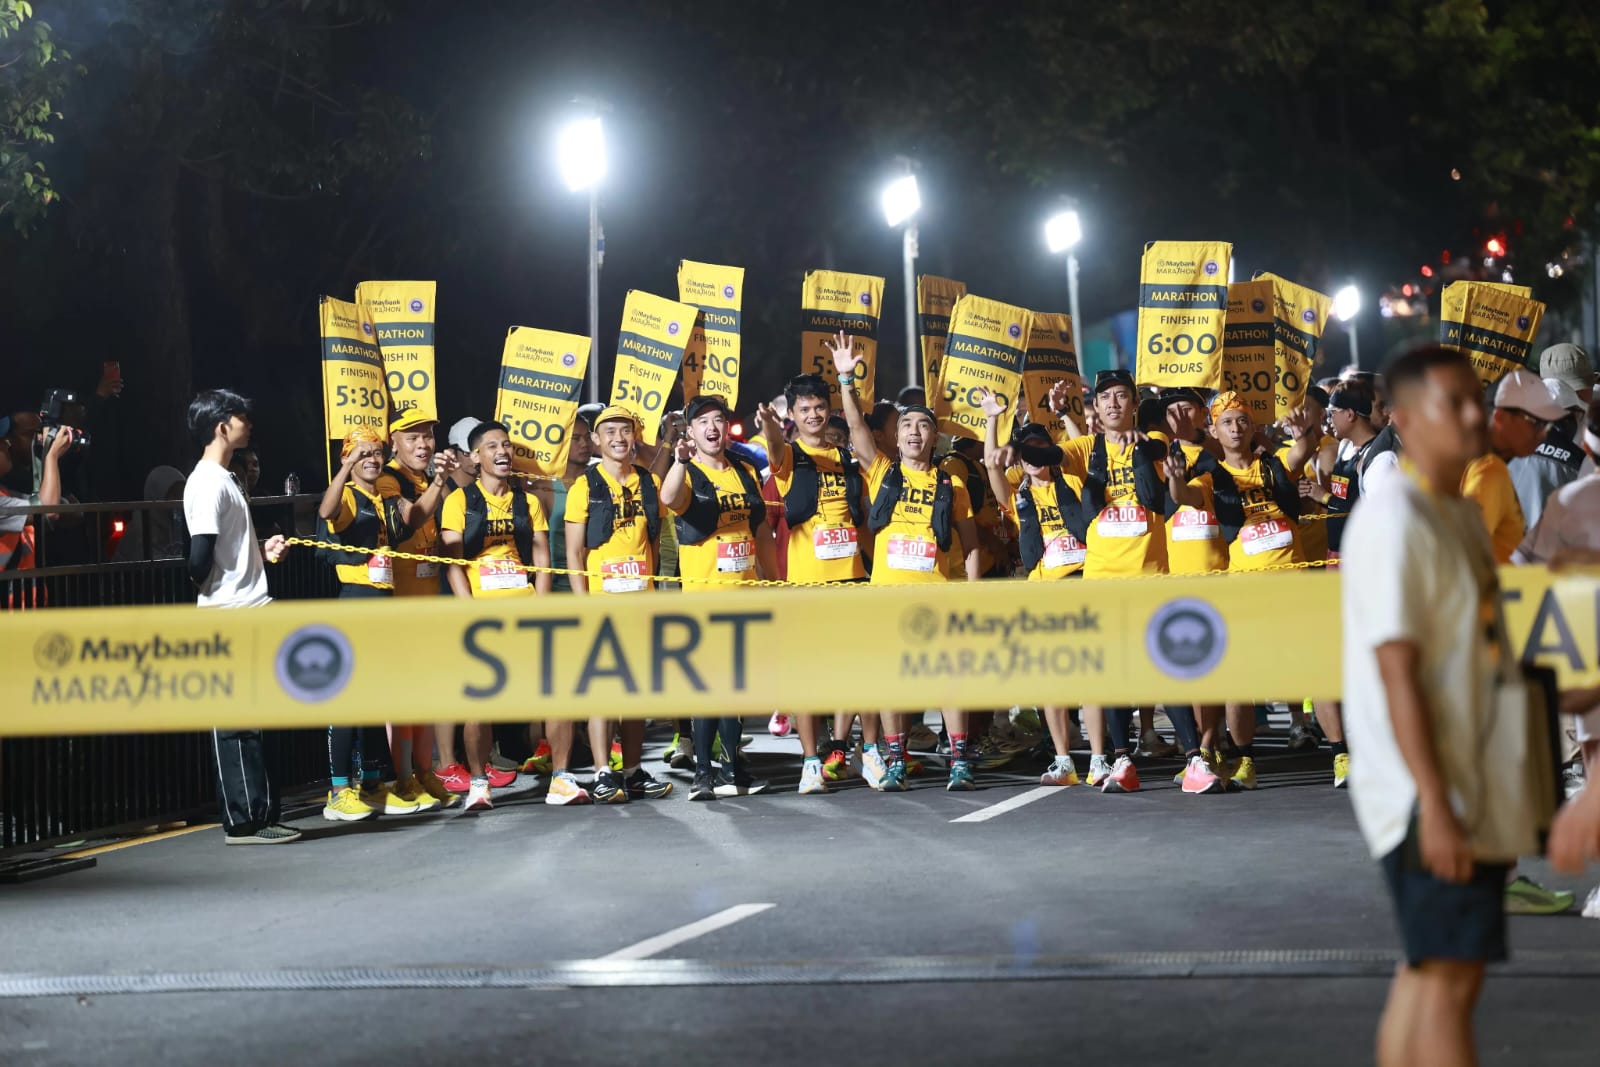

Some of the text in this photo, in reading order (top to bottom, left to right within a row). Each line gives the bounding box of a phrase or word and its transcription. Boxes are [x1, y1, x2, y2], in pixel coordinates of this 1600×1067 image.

[1156, 267, 1197, 275] MARATHON
[1166, 260, 1196, 269] Maybank
[1151, 291, 1218, 302] MARATHON
[703, 312, 736, 326] ATHON
[811, 315, 872, 331] MARATHON
[964, 319, 1001, 334] MARATHON
[973, 313, 1002, 326] Maybank
[1160, 315, 1209, 325] FINISH IN
[378, 329, 425, 340] RATHON
[721, 337, 731, 348] IN
[1224, 329, 1269, 340] RATHON
[1275, 326, 1310, 349] ATHON
[331, 343, 380, 361] MARATHON
[525, 346, 555, 357] Maybank
[854, 341, 865, 351] IN
[1148, 332, 1218, 356] 6:00
[1464, 332, 1527, 358] MARATHON
[383, 353, 418, 362] NISH IN
[515, 352, 554, 365] MARATHON
[954, 341, 1017, 365] MARATHON
[1028, 354, 1077, 368] MARATHON
[1254, 352, 1265, 362] IN
[684, 352, 738, 378] 4:00
[812, 355, 868, 380] 5:0
[1158, 362, 1204, 374] HOURS
[340, 367, 378, 381] FINISH IN
[386, 369, 430, 393] 00
[651, 370, 662, 382] IN
[959, 365, 1007, 385] FINISH IN
[1223, 370, 1272, 393] 5:30
[1275, 365, 1300, 392] 30
[507, 374, 572, 394] MARATHON
[335, 385, 386, 410] 5:30
[396, 399, 418, 412] URS
[513, 398, 561, 415] FINISH IN
[343, 414, 384, 428] HOURS
[950, 411, 988, 429] HOUR
[501, 413, 566, 445] 5:00
[513, 446, 552, 463] OURS
[1536, 442, 1571, 461] ADER
[900, 487, 934, 506] ACE
[1106, 508, 1137, 522] 6:00
[1180, 511, 1208, 525] 4:30
[822, 529, 850, 544] 5:30
[1248, 521, 1280, 540] 5:30
[726, 542, 751, 557] 4:00
[895, 540, 927, 556] 5:00
[610, 561, 640, 575] 5:00
[946, 606, 1102, 642] Maybank
[79, 632, 233, 666] Maybank
[461, 611, 774, 699] START
[900, 645, 1105, 680] MARATHON
[32, 668, 234, 706] MARATHON
